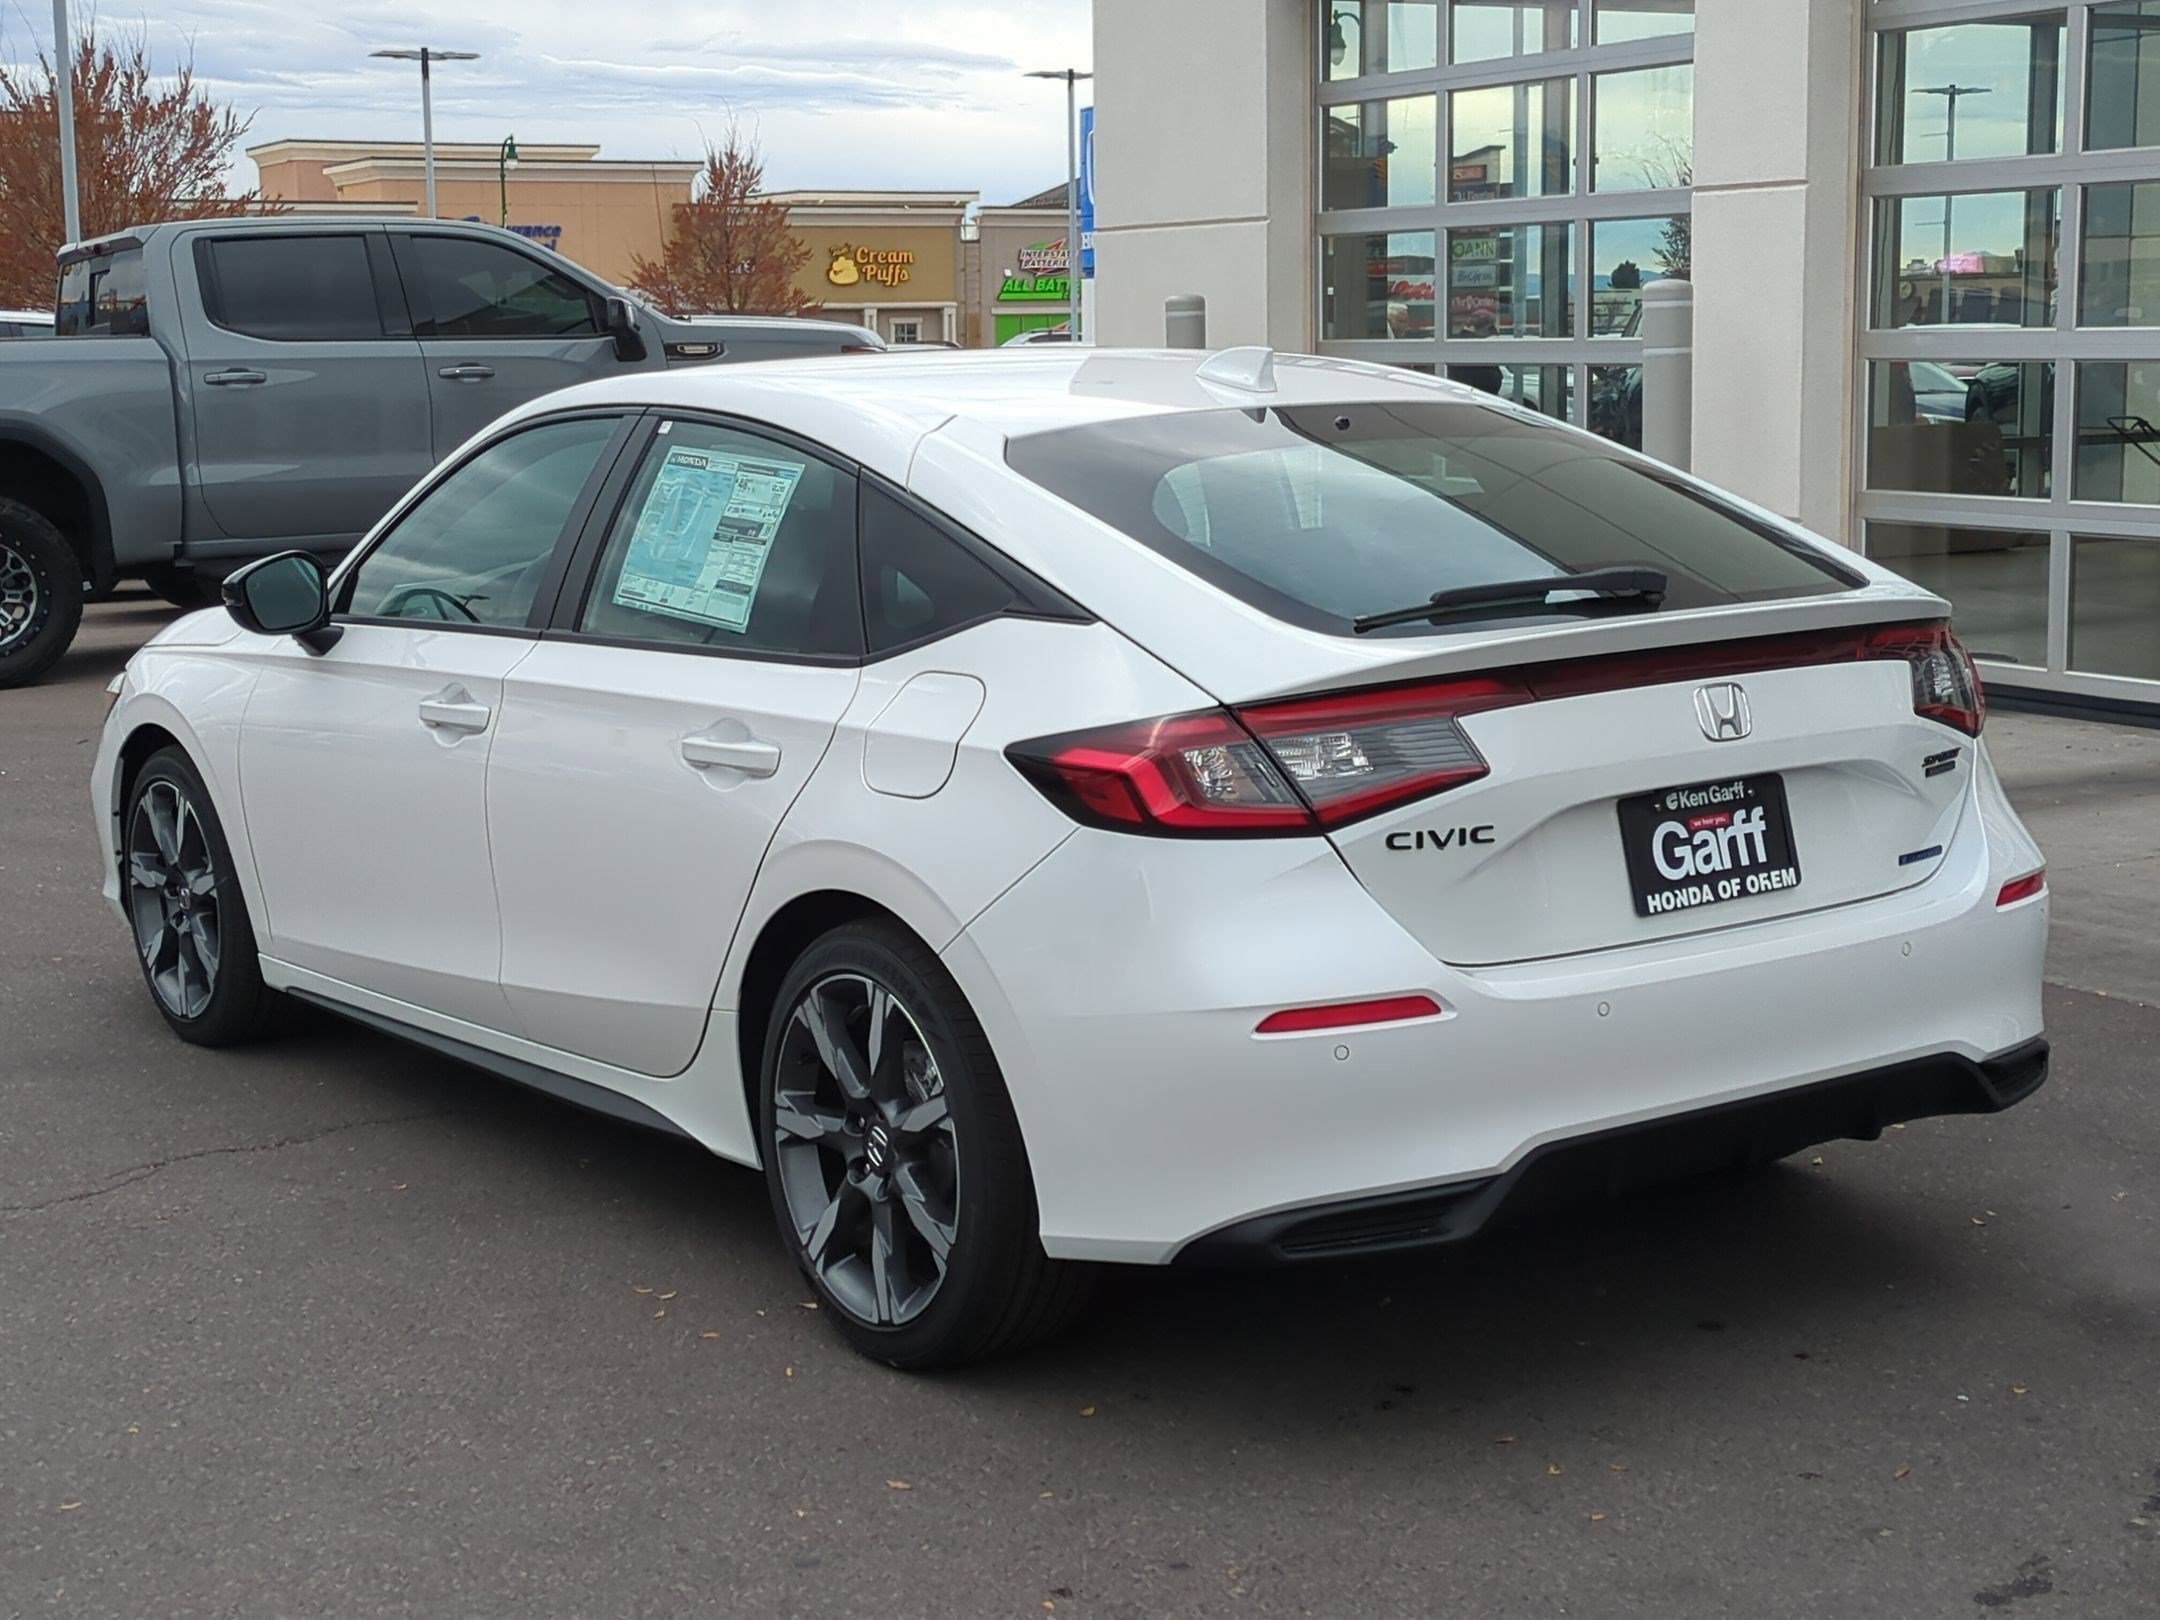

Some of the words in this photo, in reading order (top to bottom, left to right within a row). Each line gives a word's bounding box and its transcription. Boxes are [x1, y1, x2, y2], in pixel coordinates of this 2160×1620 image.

[856, 246, 914, 263] Cream
[1022, 249, 1071, 259] INTERSTA
[1453, 241, 1494, 258] OANN
[1023, 260, 1071, 268] BATTERIE
[862, 264, 909, 286] Puffs
[1003, 279, 1030, 291] ALL
[1035, 278, 1071, 291] BATT
[1679, 789, 1710, 809] Ken
[1708, 781, 1744, 803] Garff
[1385, 825, 1496, 851] CIVIC
[1652, 806, 1768, 880] Garff
[1647, 884, 1715, 914] HONDA
[1718, 877, 1742, 900] OF
[1746, 867, 1797, 893] OREM
